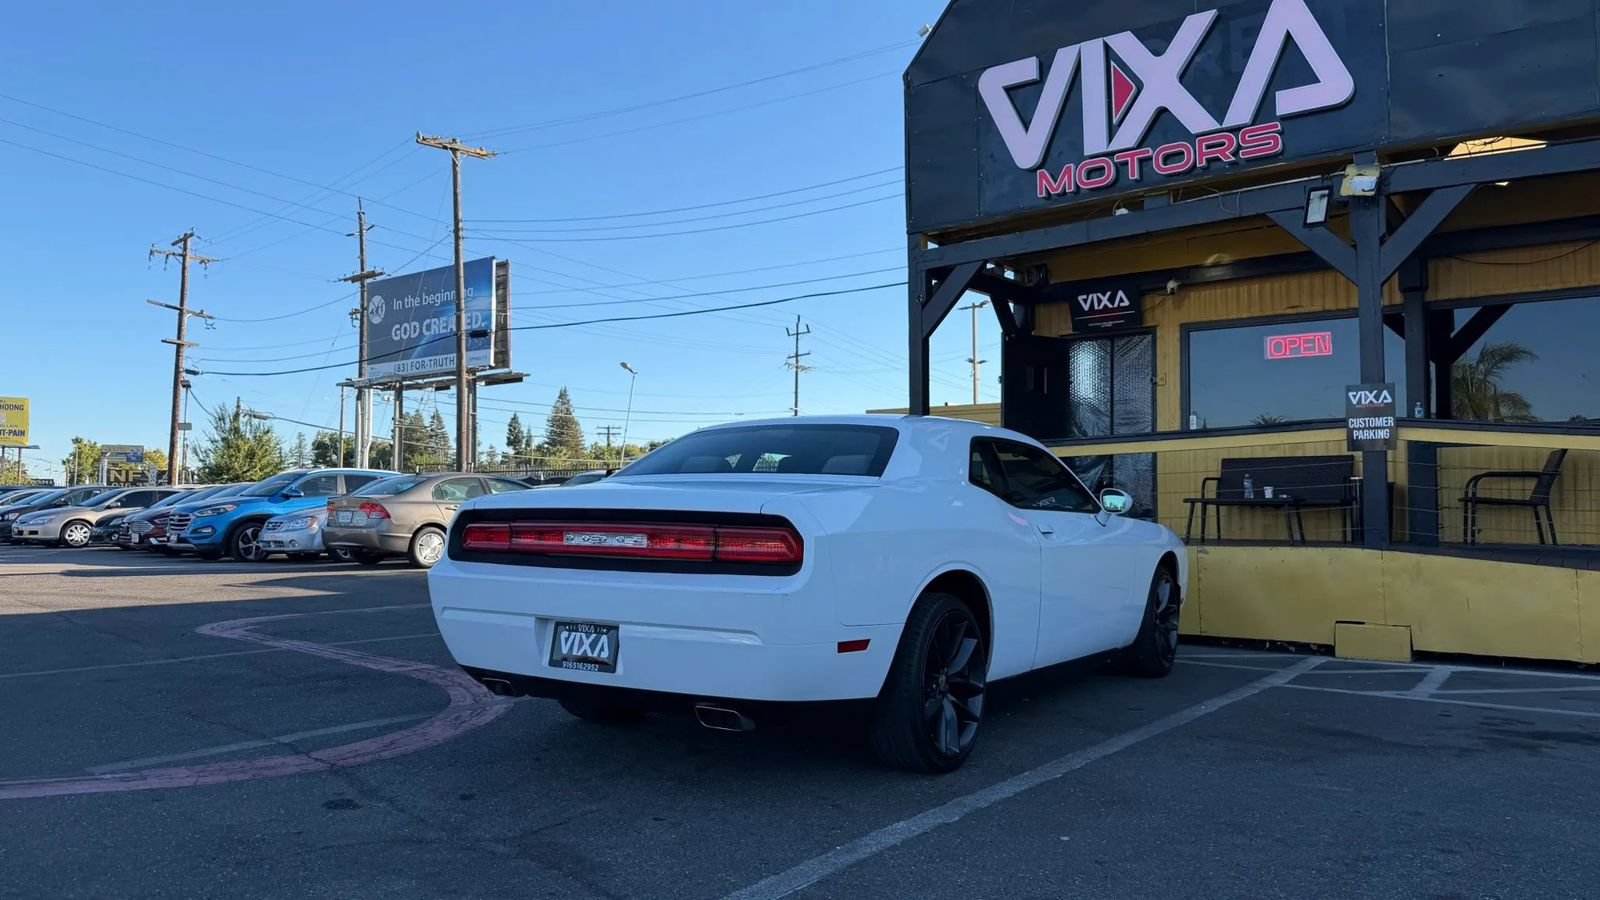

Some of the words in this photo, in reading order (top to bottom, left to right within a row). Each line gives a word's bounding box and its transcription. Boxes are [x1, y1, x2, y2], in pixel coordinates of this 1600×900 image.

[978, 0, 1354, 170] VIXA
[1036, 121, 1283, 199] MOTORS
[393, 298, 403, 310] In
[404, 294, 420, 309] the
[422, 287, 474, 306] beginng
[1077, 289, 1130, 312] VIXA
[391, 321, 420, 341] GOD
[422, 311, 487, 336] CREAED.
[1271, 335, 1329, 356] OPEN
[410, 355, 455, 371] FOR-TRUTH
[1348, 389, 1393, 405] VIXA
[1348, 416, 1394, 429] CUSTOMER
[1353, 428, 1390, 440] PARKING
[560, 630, 609, 659] VIXA
